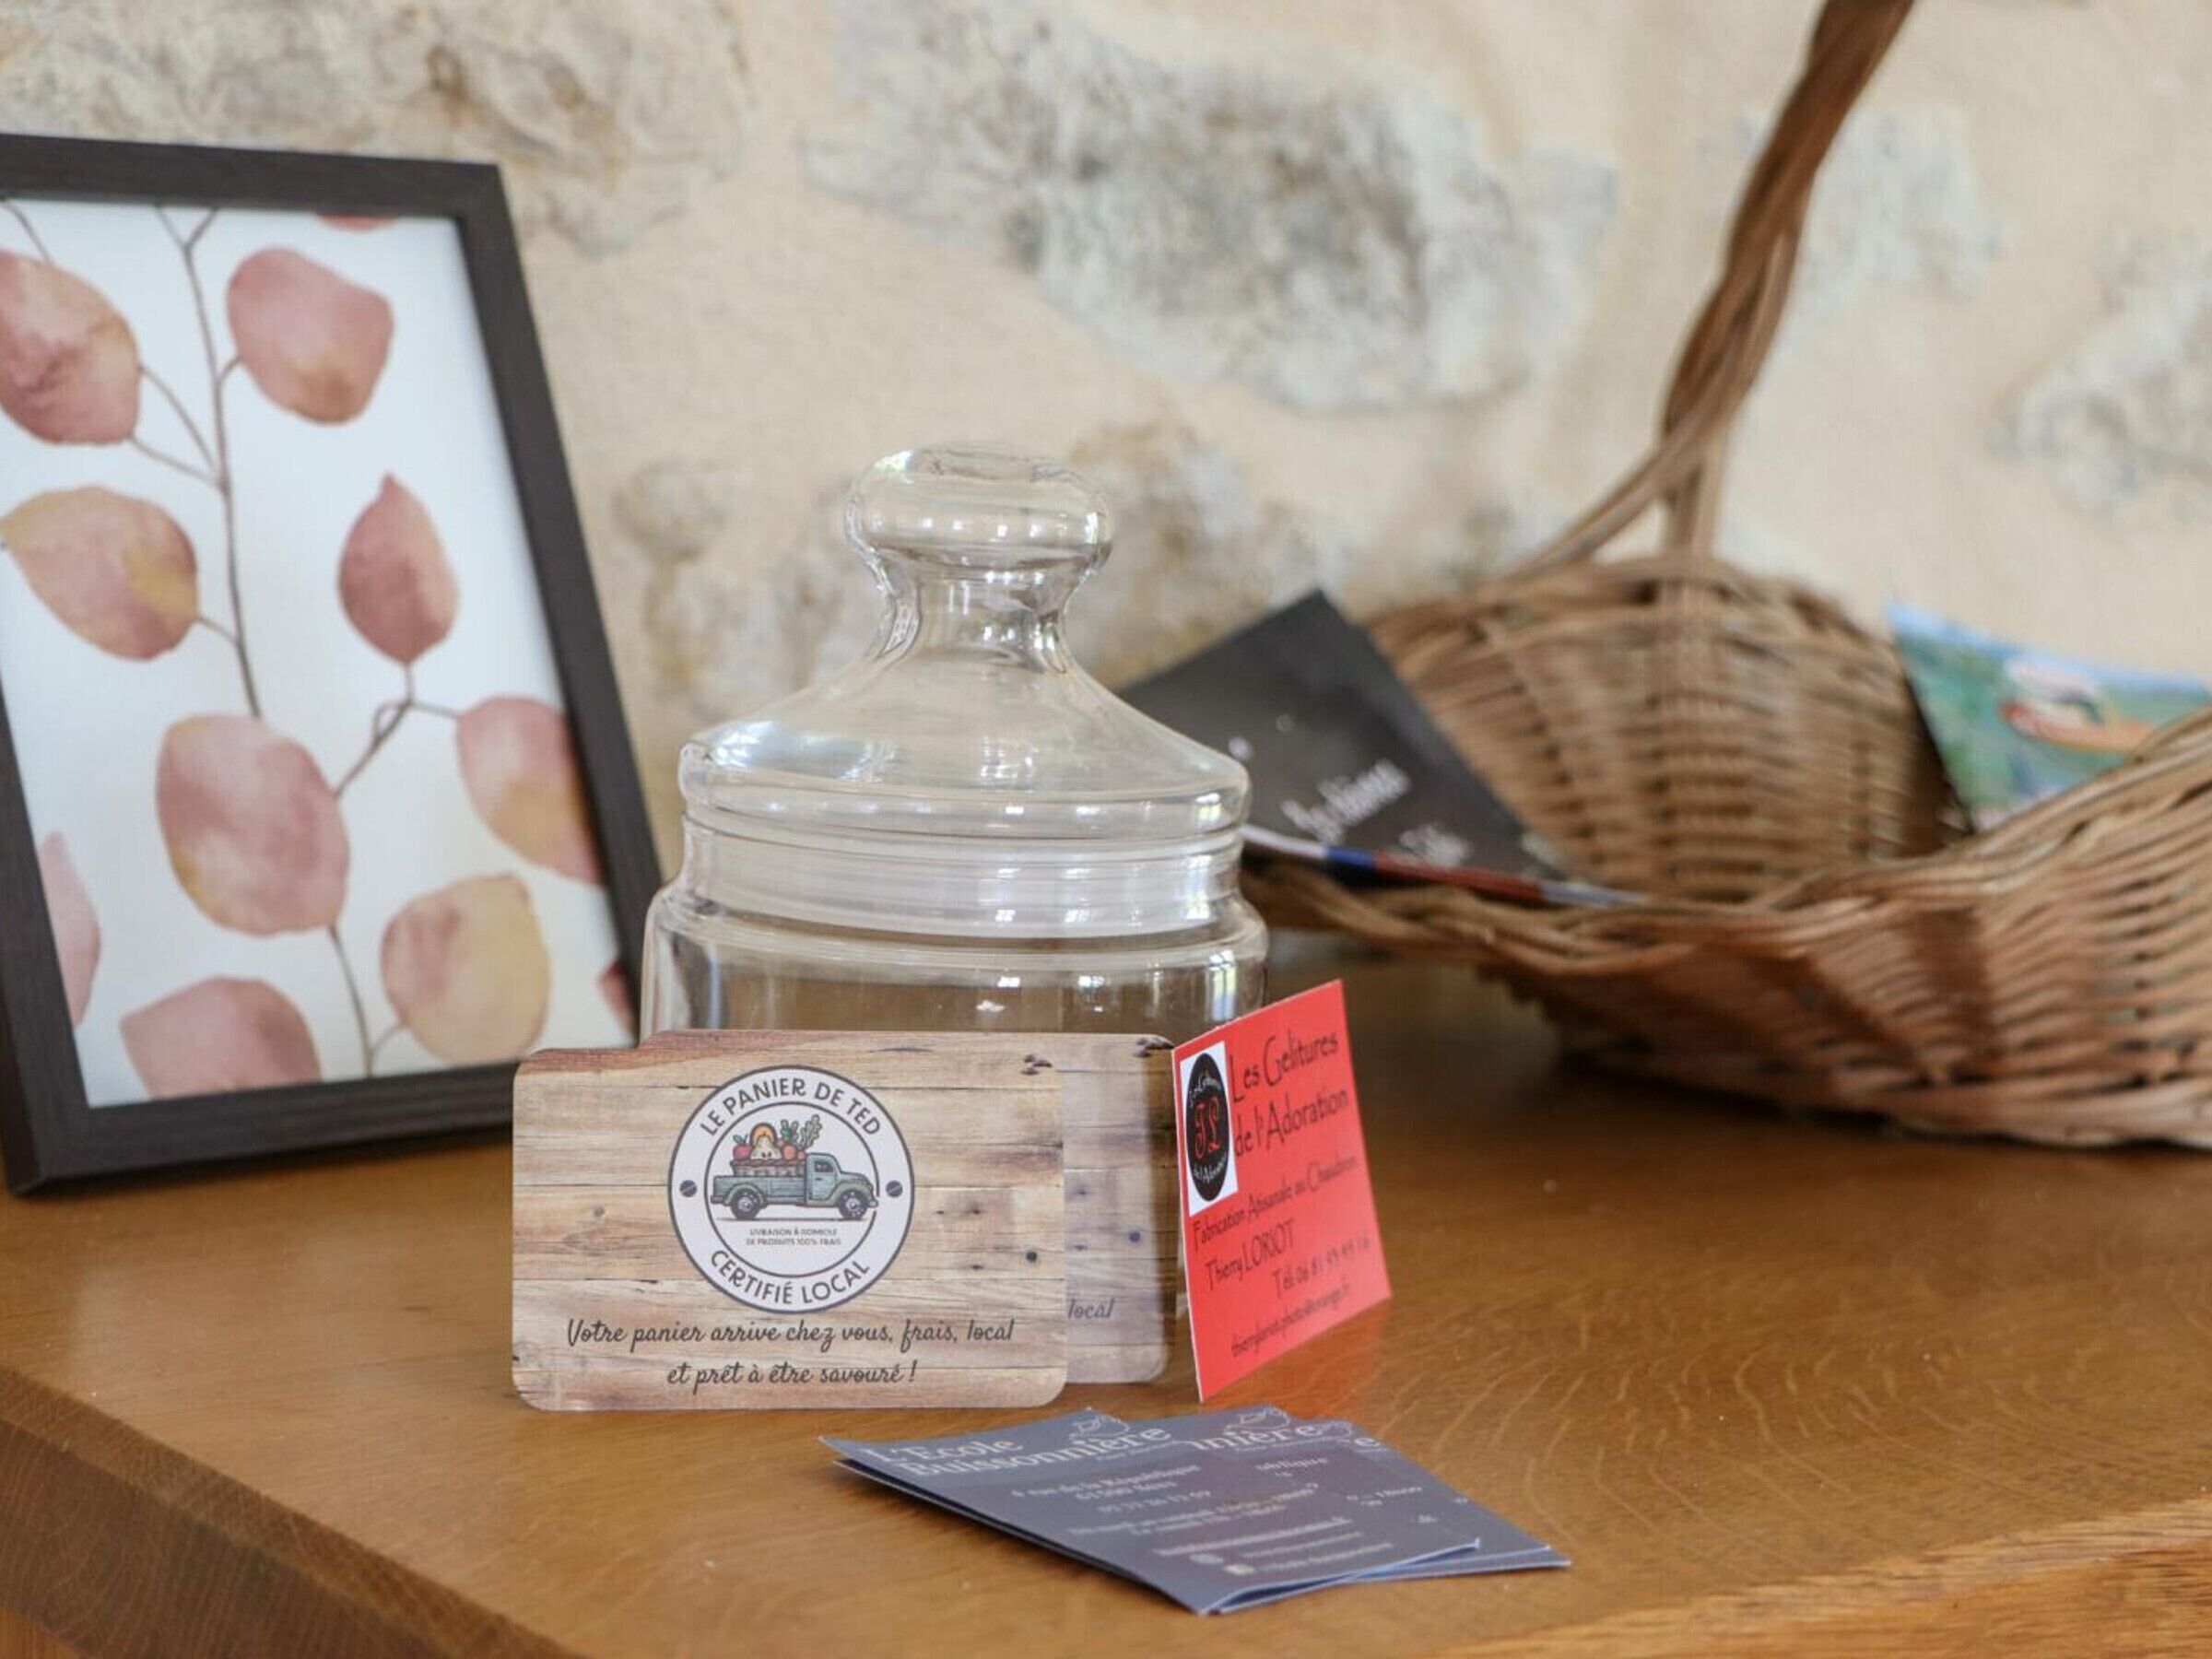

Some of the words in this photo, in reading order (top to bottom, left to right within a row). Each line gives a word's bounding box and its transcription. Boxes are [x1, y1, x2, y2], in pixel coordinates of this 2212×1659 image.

[1229, 1053, 1260, 1103] Les
[700, 1110, 725, 1137] LE
[723, 1077, 806, 1115] PANIER
[814, 1081, 844, 1107] DE
[843, 1098, 881, 1136] TED
[1234, 1112, 1254, 1158] de
[711, 1250, 794, 1305] CERTIFIÉ
[801, 1260, 870, 1304] LOCAL
[1066, 1297, 1116, 1320] local
[567, 1318, 626, 1347] Votre
[629, 1320, 705, 1353] panier
[710, 1320, 782, 1343] arrive
[786, 1319, 834, 1353] chez
[841, 1326, 893, 1343] vous,
[900, 1319, 959, 1353] frais,
[965, 1318, 1016, 1342] local
[666, 1361, 691, 1383] et
[692, 1360, 745, 1396] prêt
[747, 1363, 764, 1383] à
[768, 1360, 814, 1383] être
[818, 1365, 906, 1383] savouré
[911, 1359, 919, 1382] !
[856, 1439, 1023, 1464] L'Ecole
[896, 1427, 1172, 1476] Buissonnière
